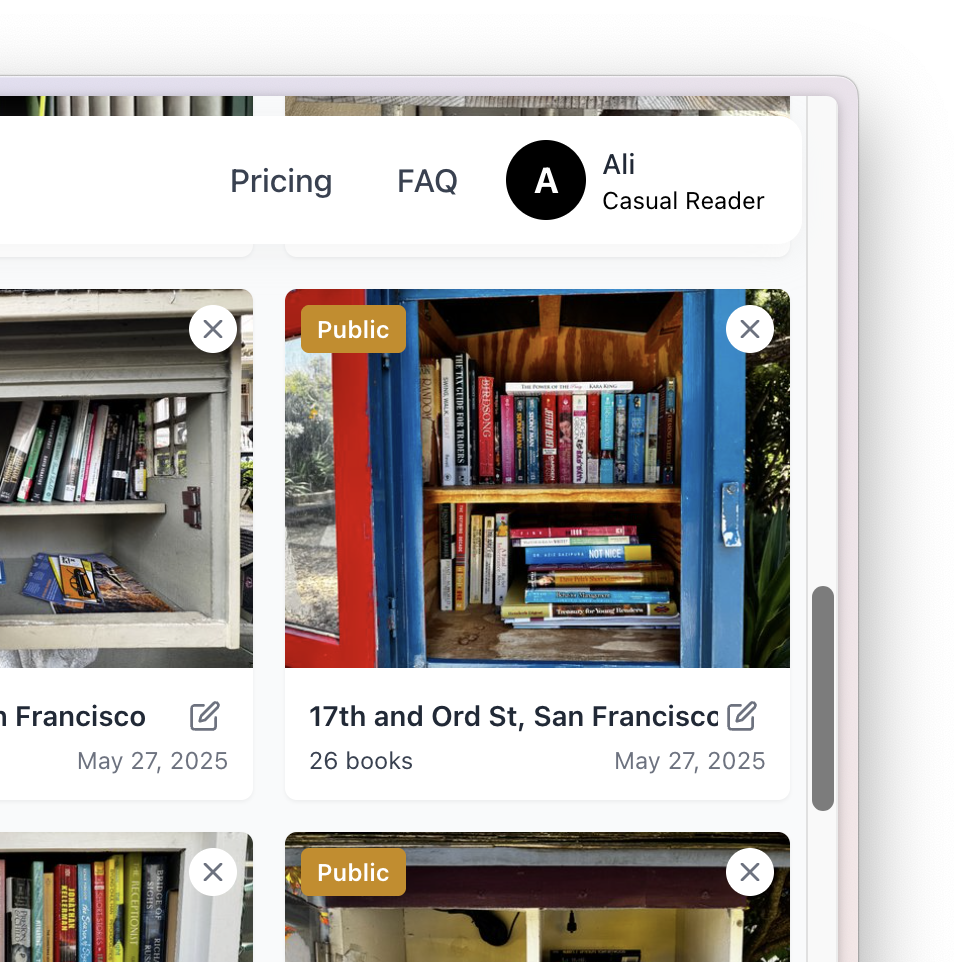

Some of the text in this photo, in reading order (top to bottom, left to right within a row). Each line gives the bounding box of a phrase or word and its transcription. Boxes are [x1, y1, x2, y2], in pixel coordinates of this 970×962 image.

[603, 153, 634, 174] Ali
[232, 168, 333, 198] Pricing
[399, 169, 457, 195] FAQ
[534, 167, 559, 193] A
[603, 191, 765, 210] Casual Reader
[318, 319, 388, 339] Public
[455, 354, 465, 464] THE TAX GUIDE FOR TRADERS
[481, 379, 492, 438] BIRDSONG
[589, 548, 622, 559] NOT NICE
[17, 704, 145, 727] Francisco
[310, 705, 365, 726] 17th
[374, 705, 422, 727] and
[432, 705, 480, 727] Ord
[490, 705, 524, 732] St,
[535, 705, 583, 727] San
[79, 751, 227, 774] May 27, 2025
[310, 751, 412, 770] 26 books
[616, 751, 765, 774] May 27, 2025
[318, 862, 388, 882] Public
[146, 881, 154, 910] SIGHS
[156, 869, 164, 921] BRIDGE OF
[67, 888, 76, 929] JONATHAN
[130, 880, 140, 946] RECEPTIONIST
